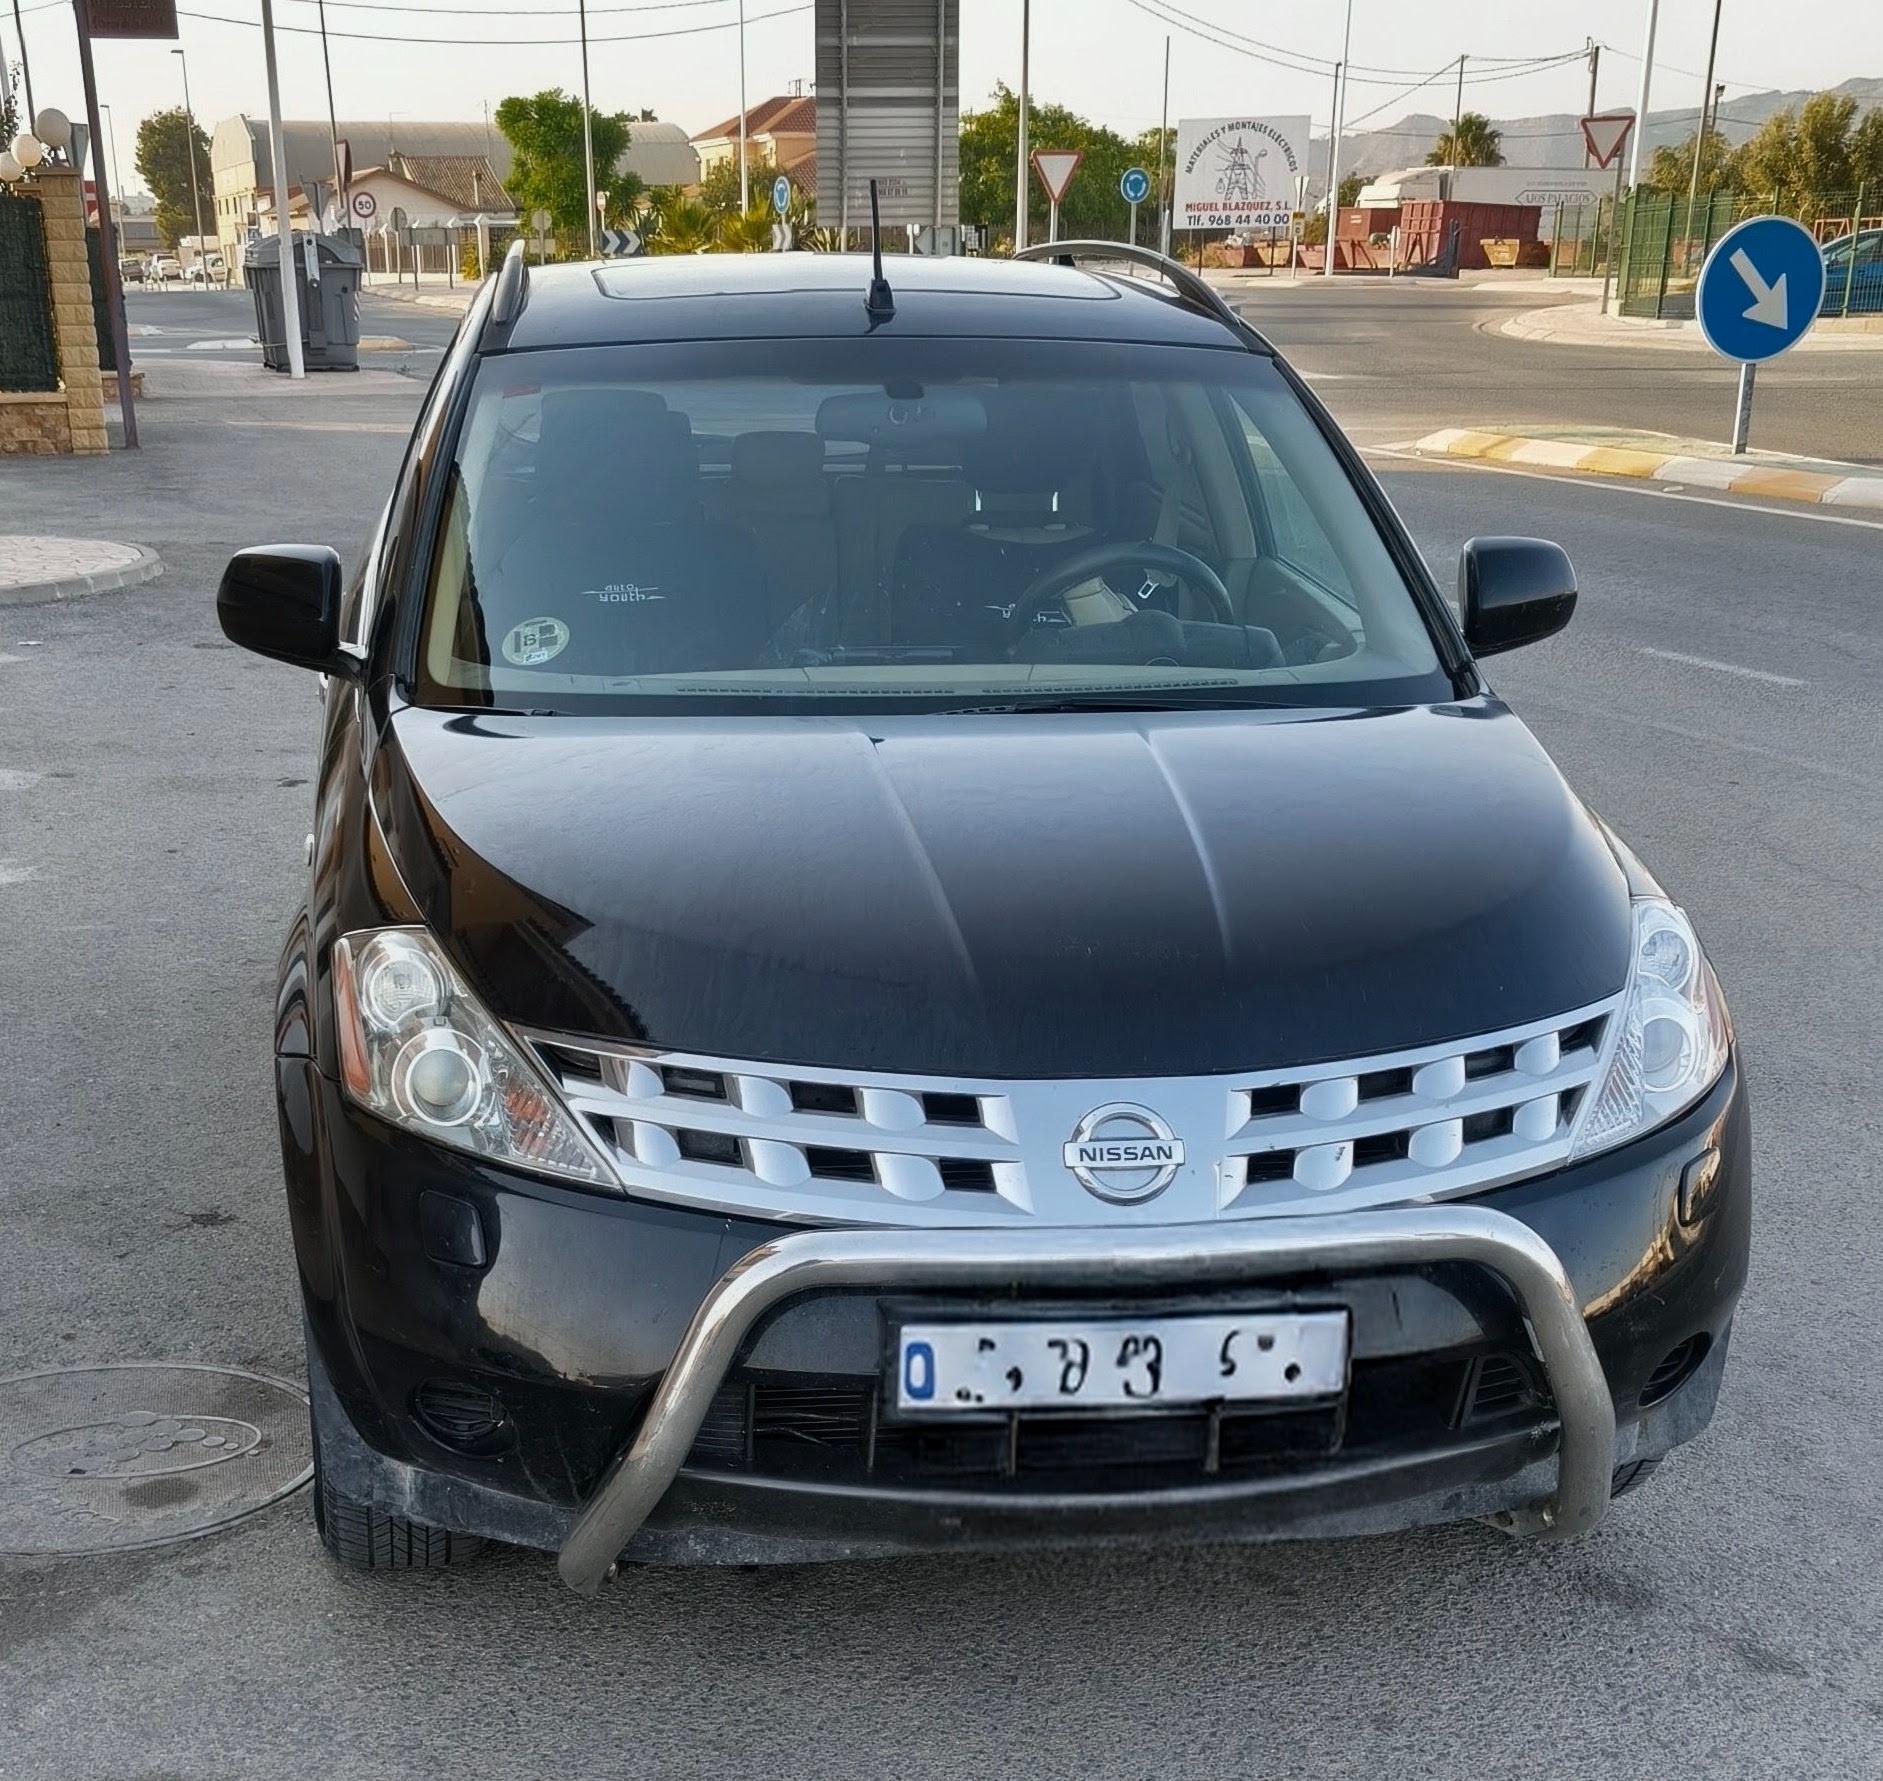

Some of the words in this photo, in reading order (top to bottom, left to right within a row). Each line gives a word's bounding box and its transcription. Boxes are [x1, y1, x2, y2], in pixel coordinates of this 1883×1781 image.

[1185, 129, 1221, 175] MATERIALES
[1227, 121, 1269, 134] MONTAJES
[358, 200, 371, 210] 50
[1185, 202, 1219, 212] MIGUEL
[1208, 214, 1231, 226] 968
[1235, 214, 1250, 225] 44
[1255, 213, 1270, 225] 40
[1273, 213, 1290, 225] 00
[600, 588, 645, 602] youth
[1079, 1146, 1172, 1162] NISSAN
